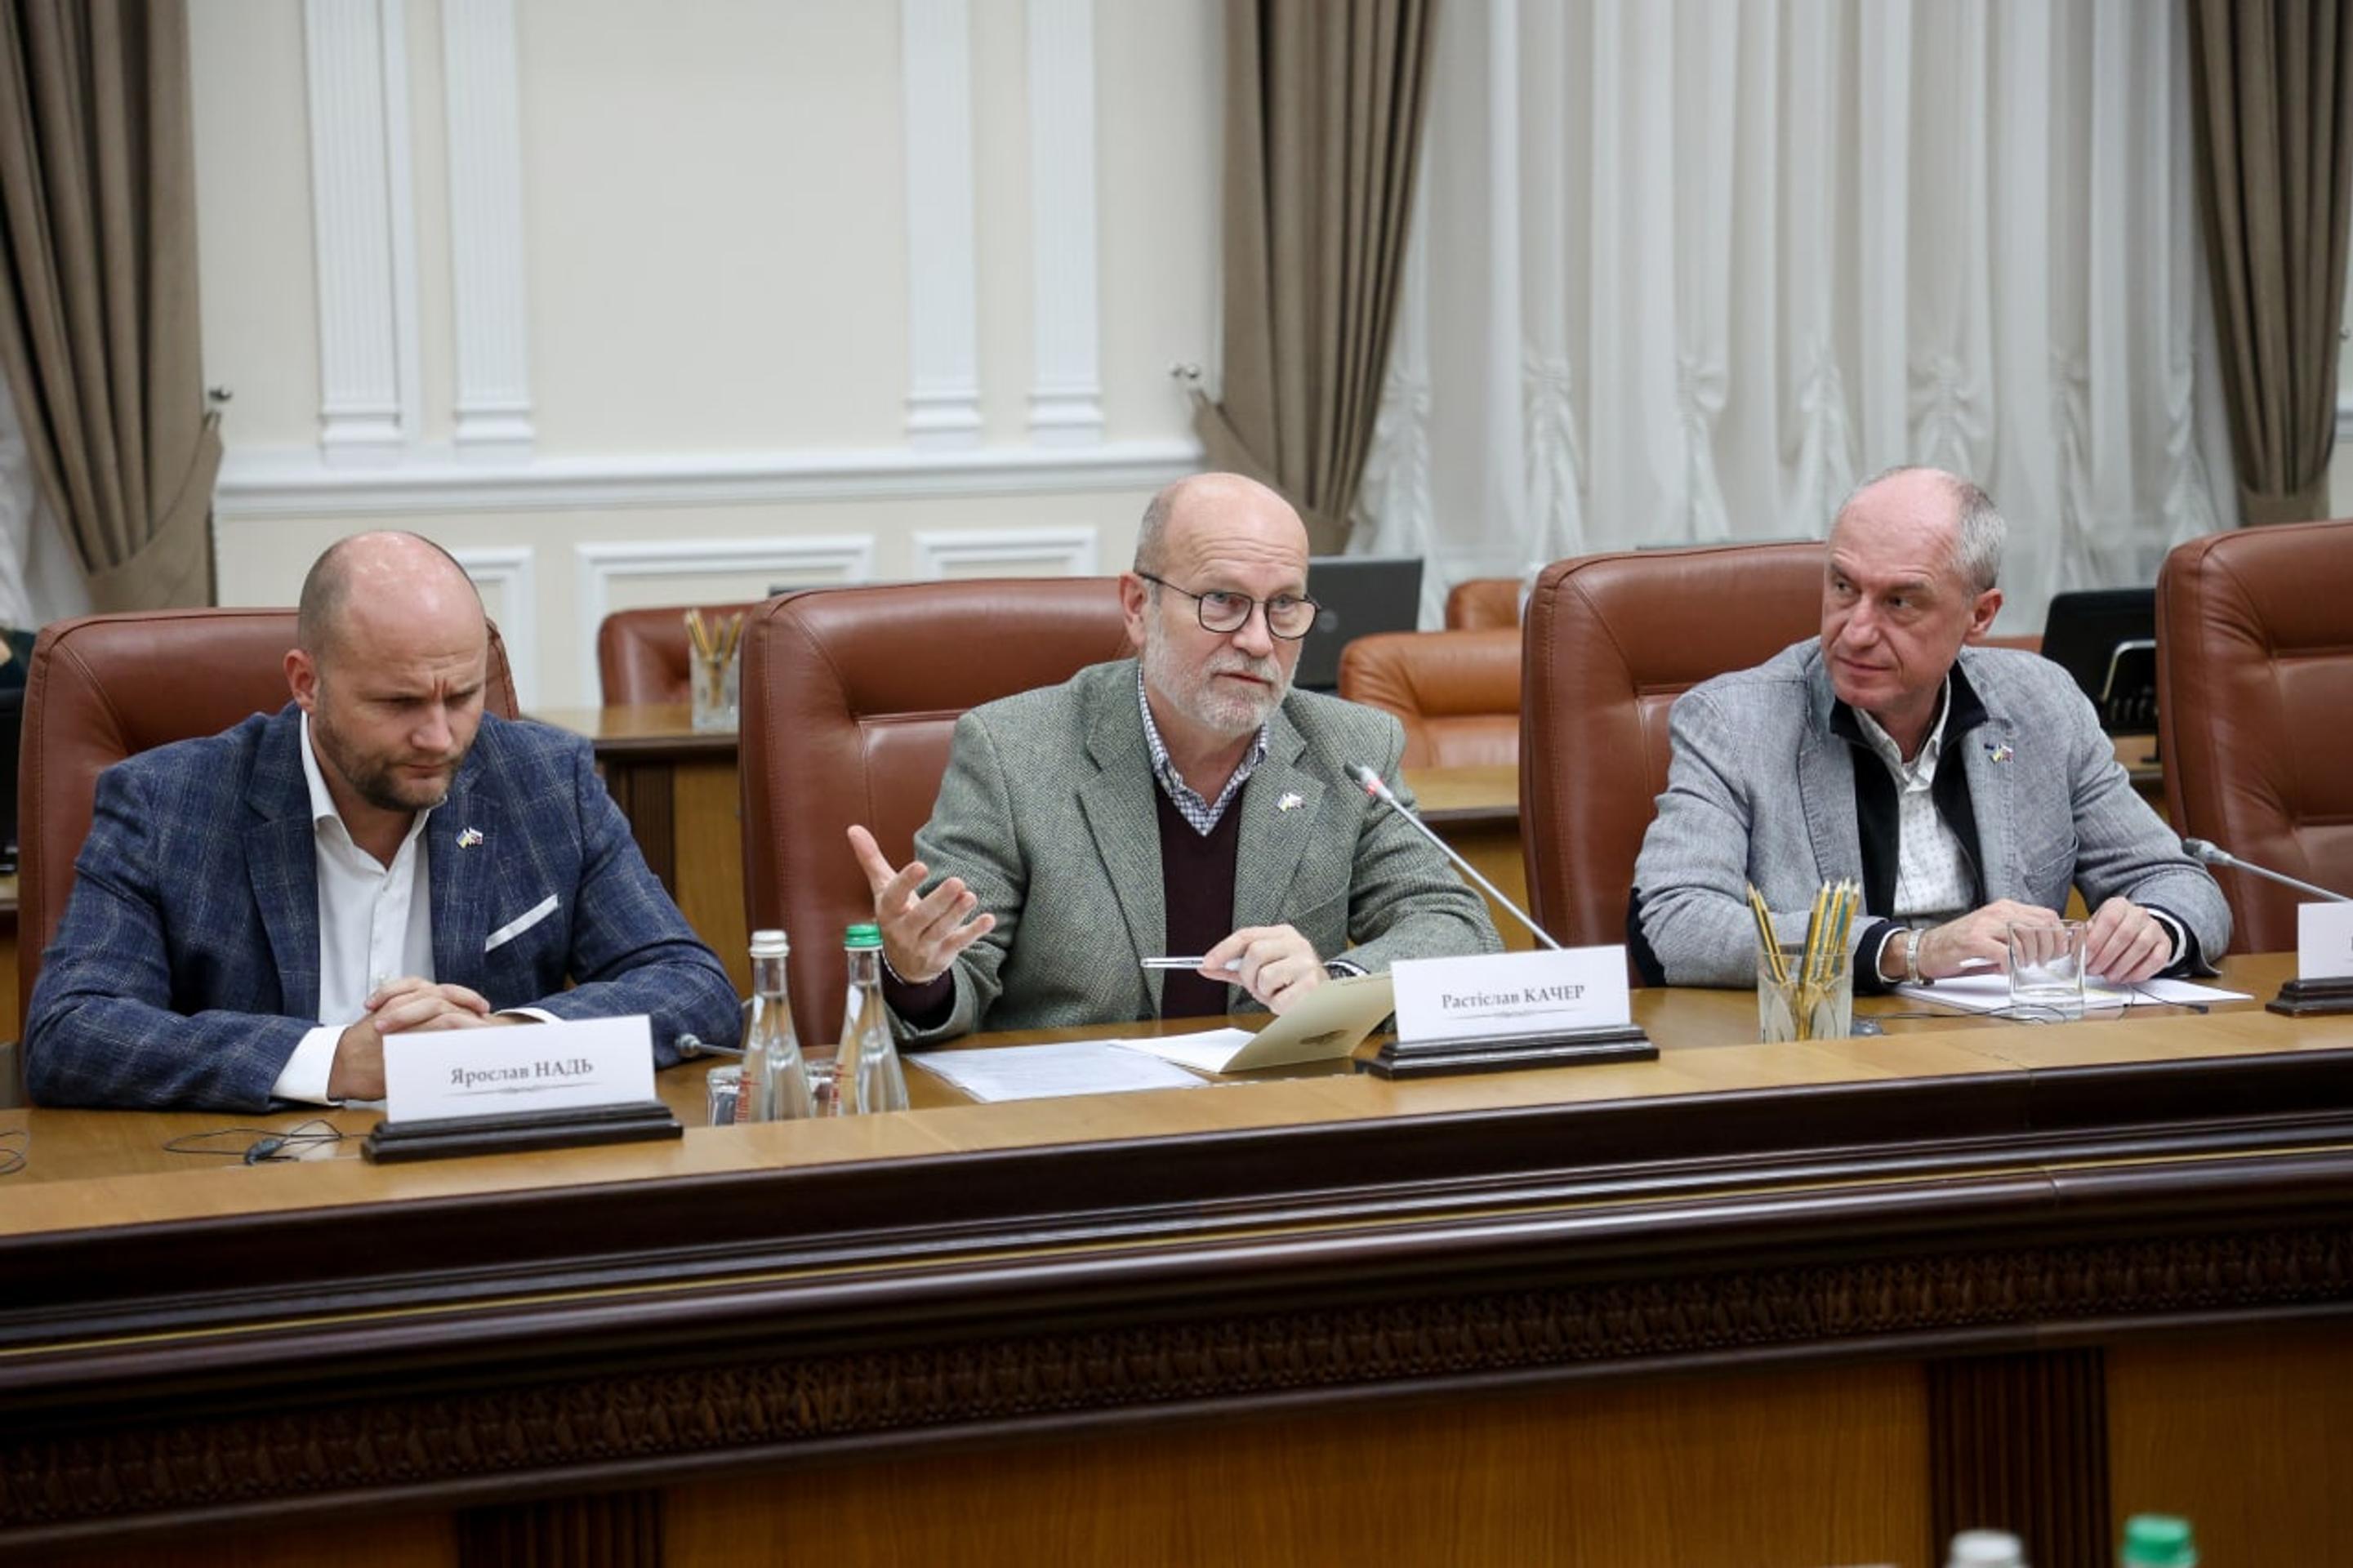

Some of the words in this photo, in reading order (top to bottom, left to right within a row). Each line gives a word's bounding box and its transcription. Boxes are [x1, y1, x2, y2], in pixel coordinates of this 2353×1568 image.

[1442, 992, 1520, 1009] Растіслав
[1524, 985, 1585, 1003] КАЧЕР
[451, 1067, 529, 1088] Ярослав
[535, 1058, 594, 1077] НАДЬ
